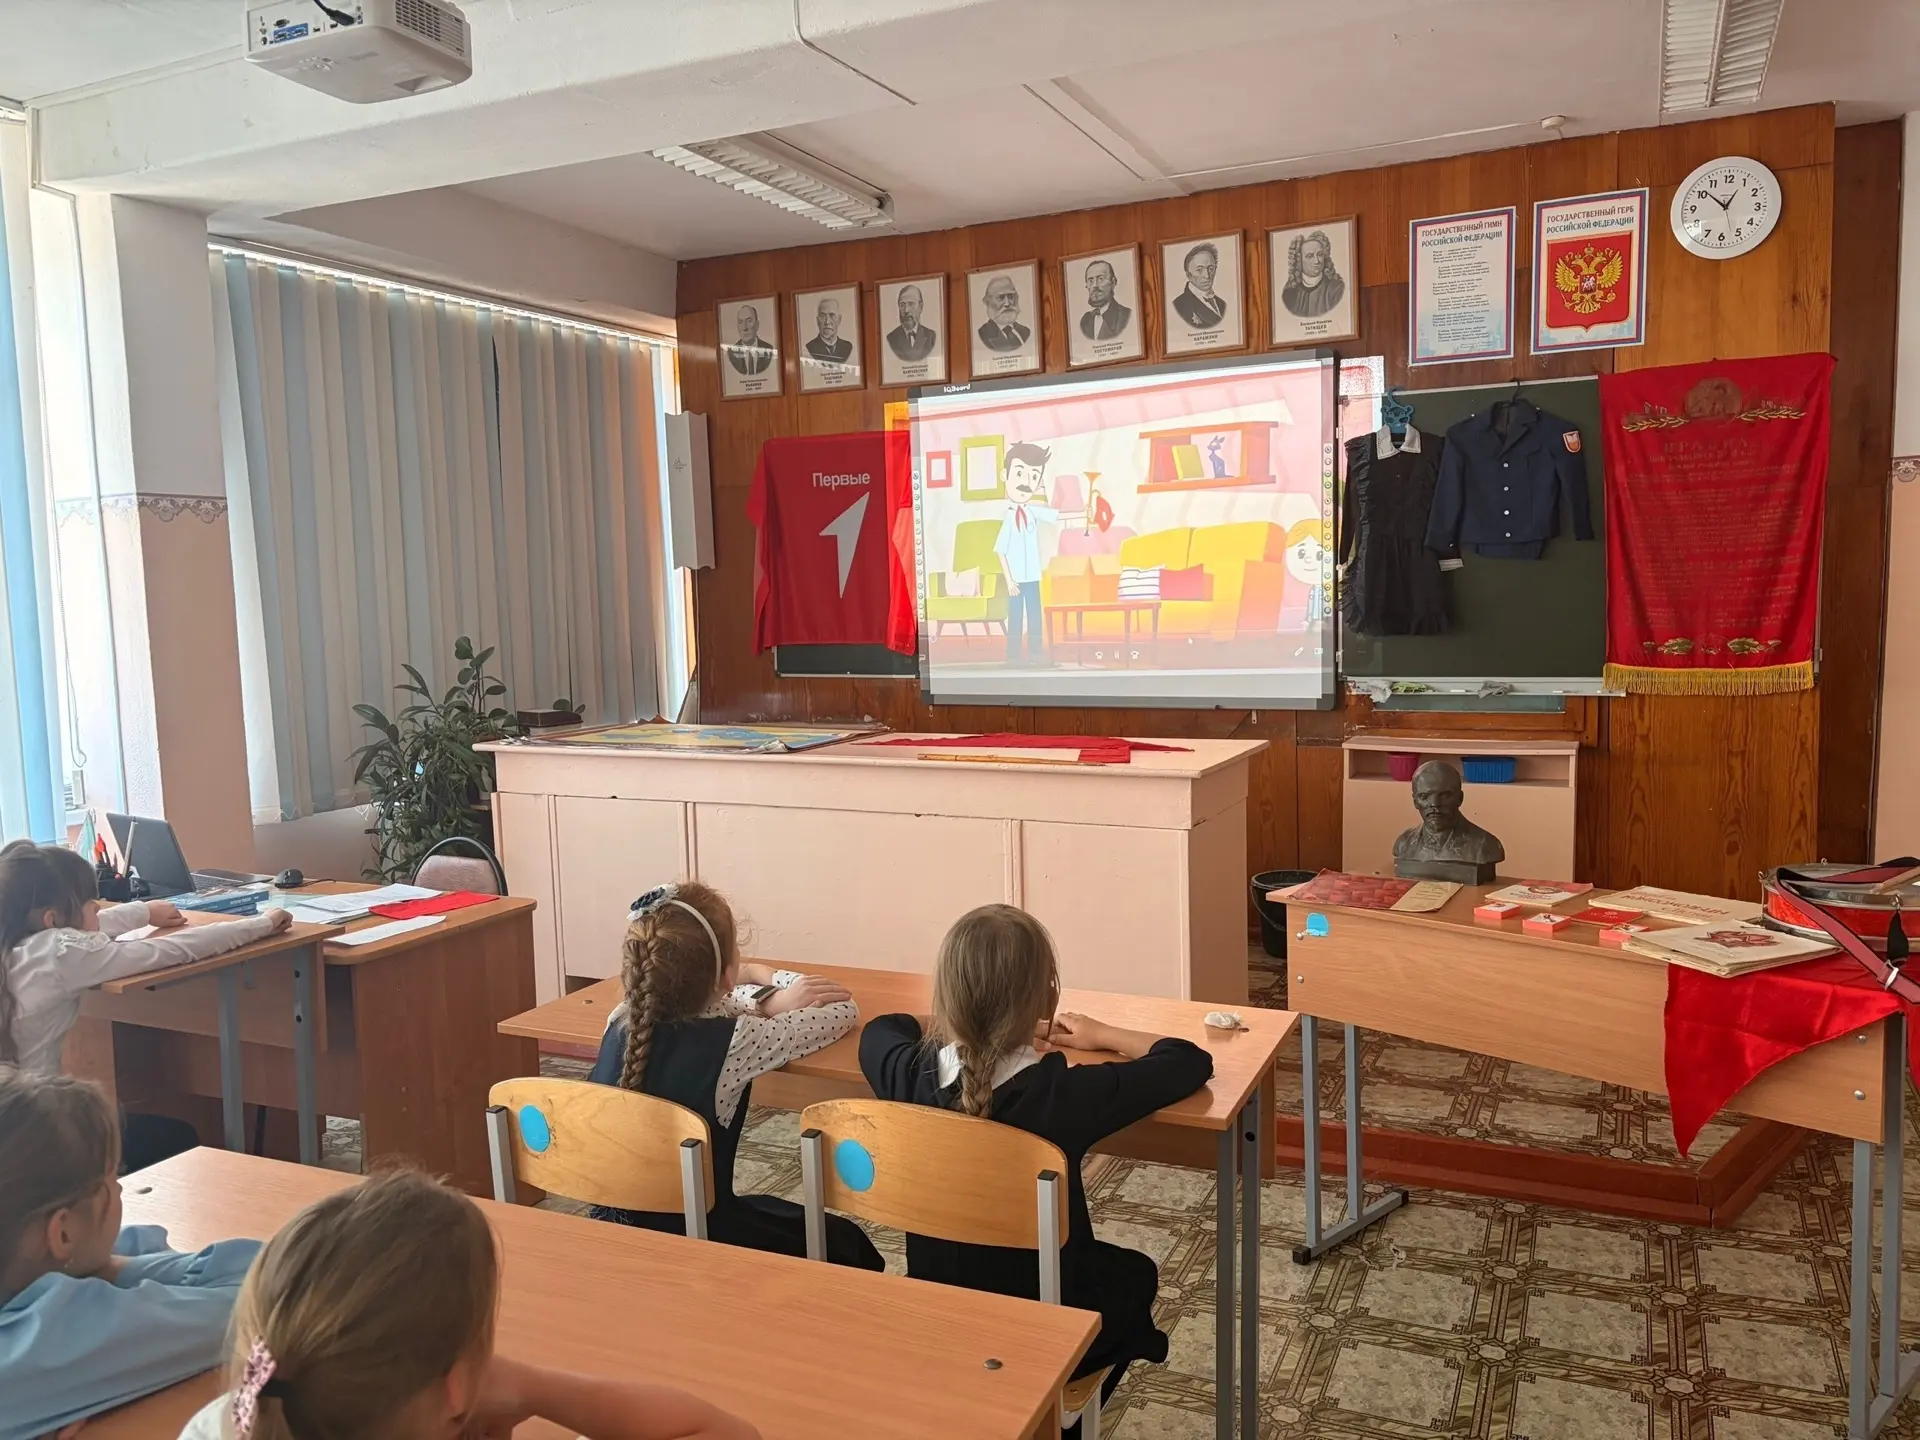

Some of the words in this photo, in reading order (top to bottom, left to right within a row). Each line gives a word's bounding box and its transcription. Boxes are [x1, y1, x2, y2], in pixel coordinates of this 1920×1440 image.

[1709, 180, 1718, 188] 11
[1724, 175, 1735, 184] 12
[1742, 178, 1747, 187] 1
[1697, 190, 1708, 199] 10
[1751, 188, 1758, 197] 2
[1690, 205, 1697, 214] 9
[1754, 202, 1761, 212] 3
[1547, 206, 1616, 223] ГОСУДАРСТВЕННЫЙ
[1617, 205, 1635, 214] ГЕРБ
[1546, 220, 1592, 234] РОССИЙСКОЙ
[1592, 216, 1635, 228] ФЕДЕРАЦИИ
[1693, 219, 1700, 228] 8
[1747, 217, 1754, 226] 4
[1422, 221, 1484, 237] ГОСУДАРСТВЕННЫЙ
[1484, 219, 1503, 229] ГИМН
[1735, 228, 1742, 237] 5
[1705, 229, 1712, 238] 7
[1718, 232, 1725, 241] 6
[1421, 234, 1463, 248] РОССИЙСКОЙ
[1463, 230, 1503, 242] ФЕДЕРАЦИИ
[943, 383, 971, 394] IQBoard
[812, 472, 871, 491] Первые
